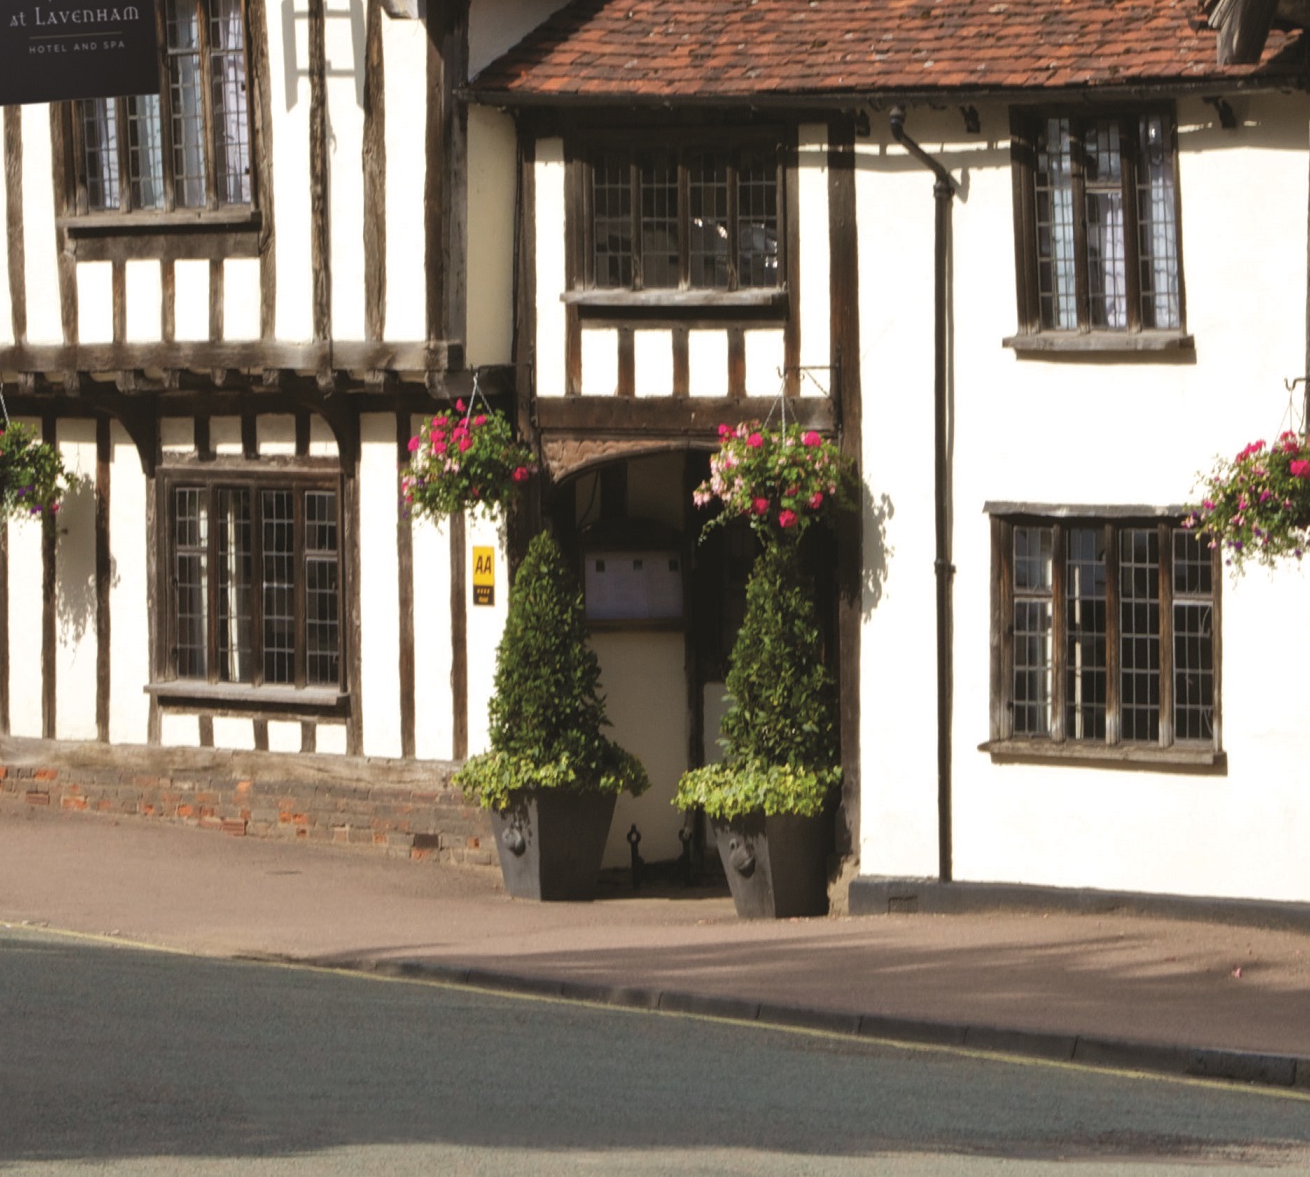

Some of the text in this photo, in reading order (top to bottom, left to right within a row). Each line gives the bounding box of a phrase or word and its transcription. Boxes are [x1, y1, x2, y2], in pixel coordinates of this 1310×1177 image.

[29, 40, 125, 54] HOTEL AND SPA
[475, 555, 492, 575] AA
